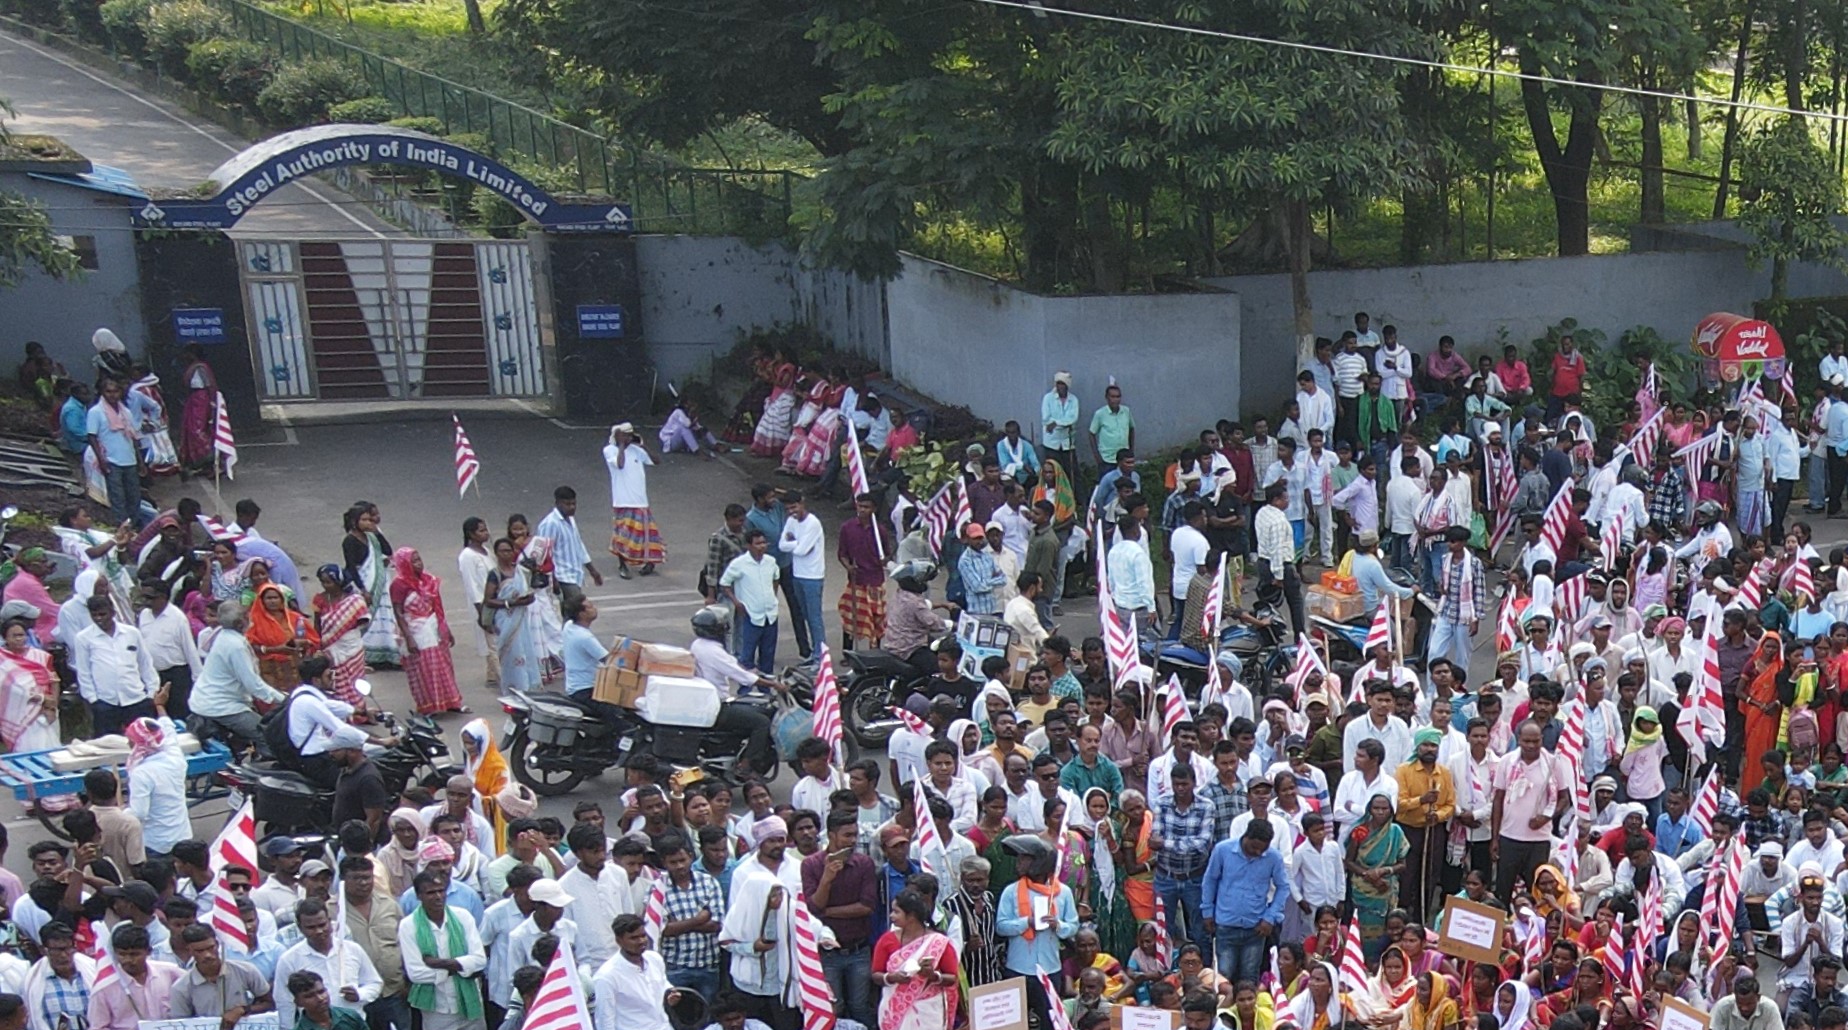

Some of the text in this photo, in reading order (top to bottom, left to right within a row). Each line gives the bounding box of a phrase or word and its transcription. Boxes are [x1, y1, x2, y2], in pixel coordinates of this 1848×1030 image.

[225, 140, 548, 216] Steel Authority of India Limited
